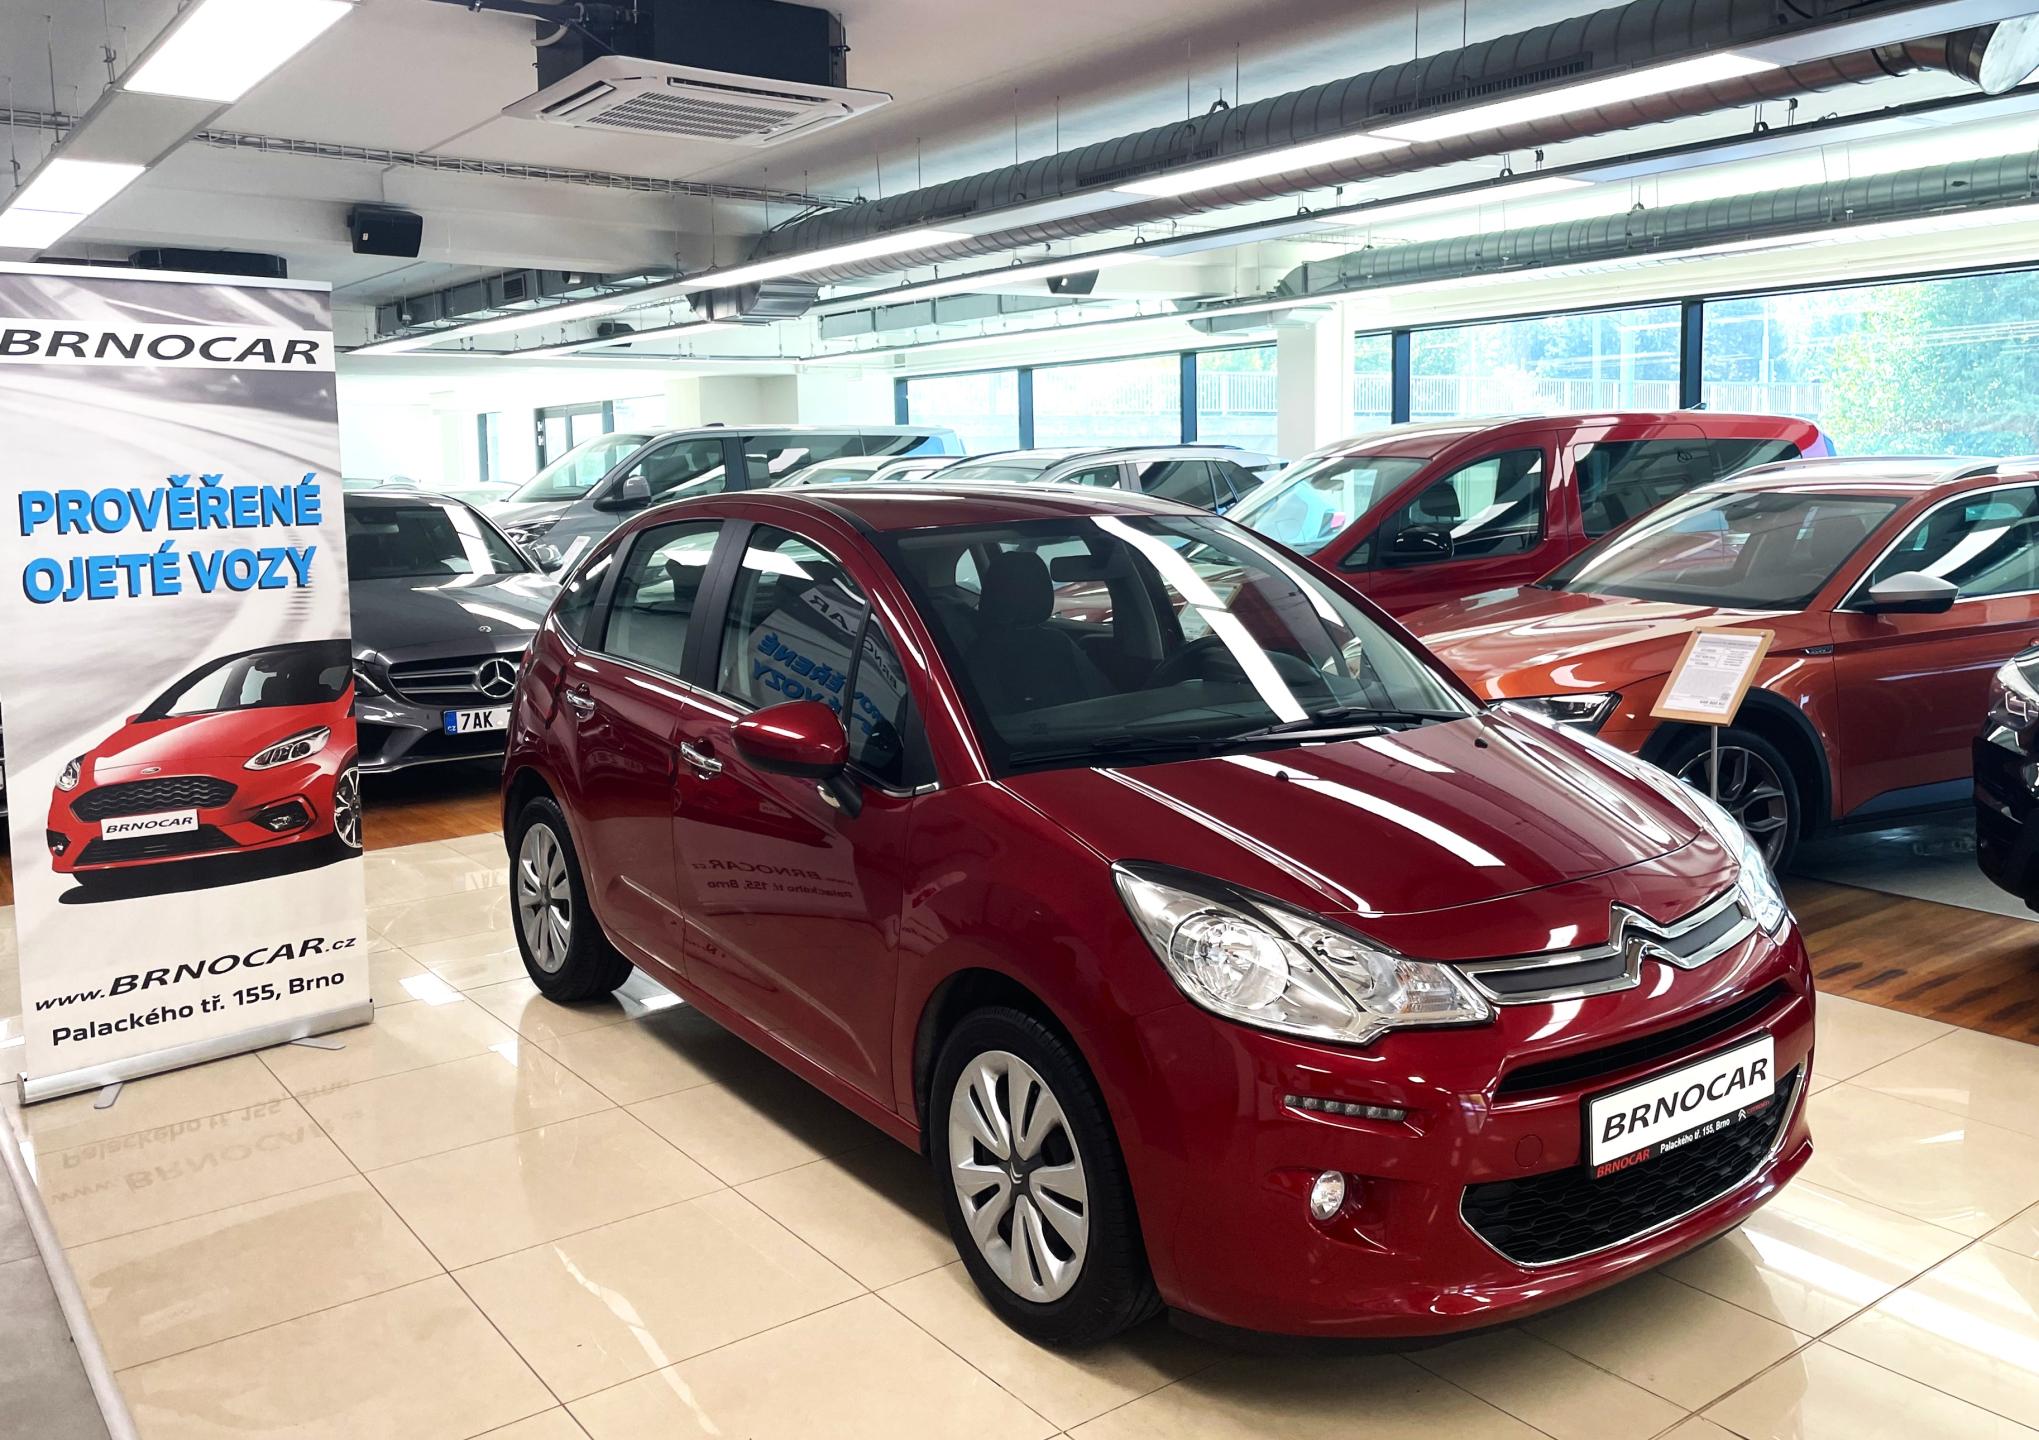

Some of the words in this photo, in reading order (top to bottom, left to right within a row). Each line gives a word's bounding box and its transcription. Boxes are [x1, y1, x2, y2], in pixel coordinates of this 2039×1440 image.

[0, 328, 320, 365] BRNOCAR
[18, 472, 323, 537] PROVĚŘENÉ
[22, 539, 182, 604] OJETÉ
[188, 545, 317, 593] VOZY
[461, 711, 493, 731] 7AK
[105, 816, 193, 834] BRNOCAR
[35, 937, 357, 1012] www.BRNOCAR.cz
[52, 1005, 194, 1047] Palackého
[200, 994, 225, 1013] tř.
[233, 983, 281, 1006] 155,
[288, 972, 345, 995] Brno
[1601, 1057, 1768, 1144] BRNOCAR
[1596, 1149, 1650, 1178] BRNOCAR
[1660, 1134, 1693, 1154] Palackého
[1716, 1118, 1731, 1131] Brno
